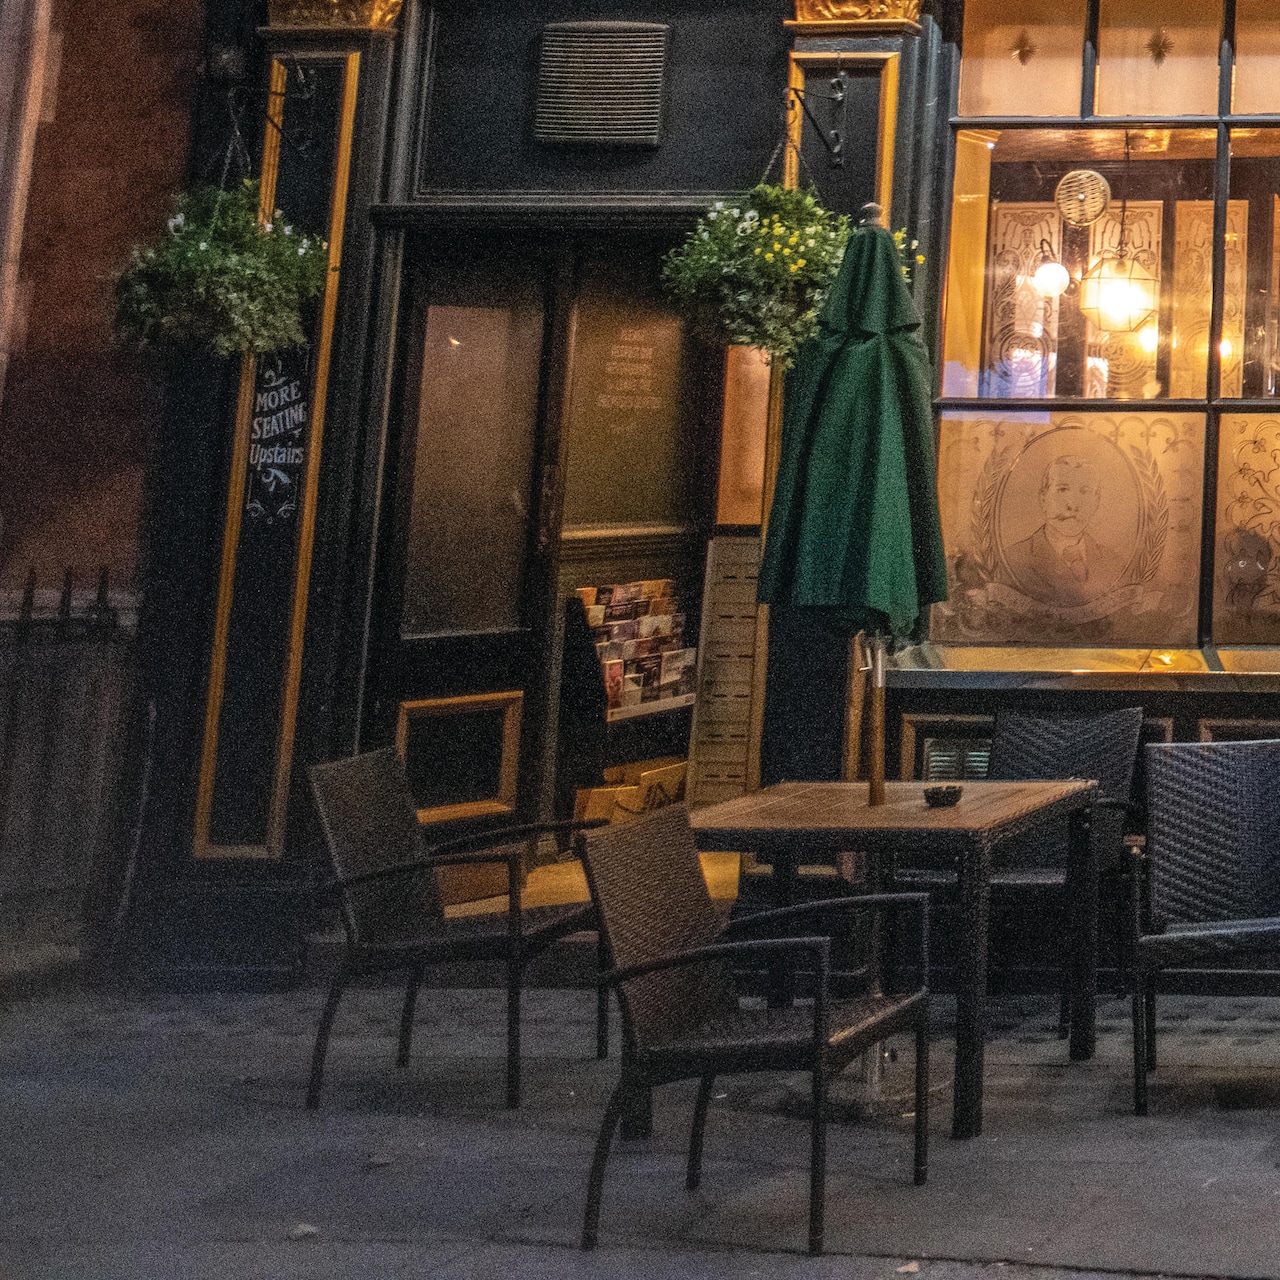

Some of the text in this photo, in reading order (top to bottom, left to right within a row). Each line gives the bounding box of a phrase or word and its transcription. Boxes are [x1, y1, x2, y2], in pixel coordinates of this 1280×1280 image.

[255, 380, 301, 412] MORE
[251, 402, 308, 440] SEATING
[250, 441, 305, 470] Upstairs
